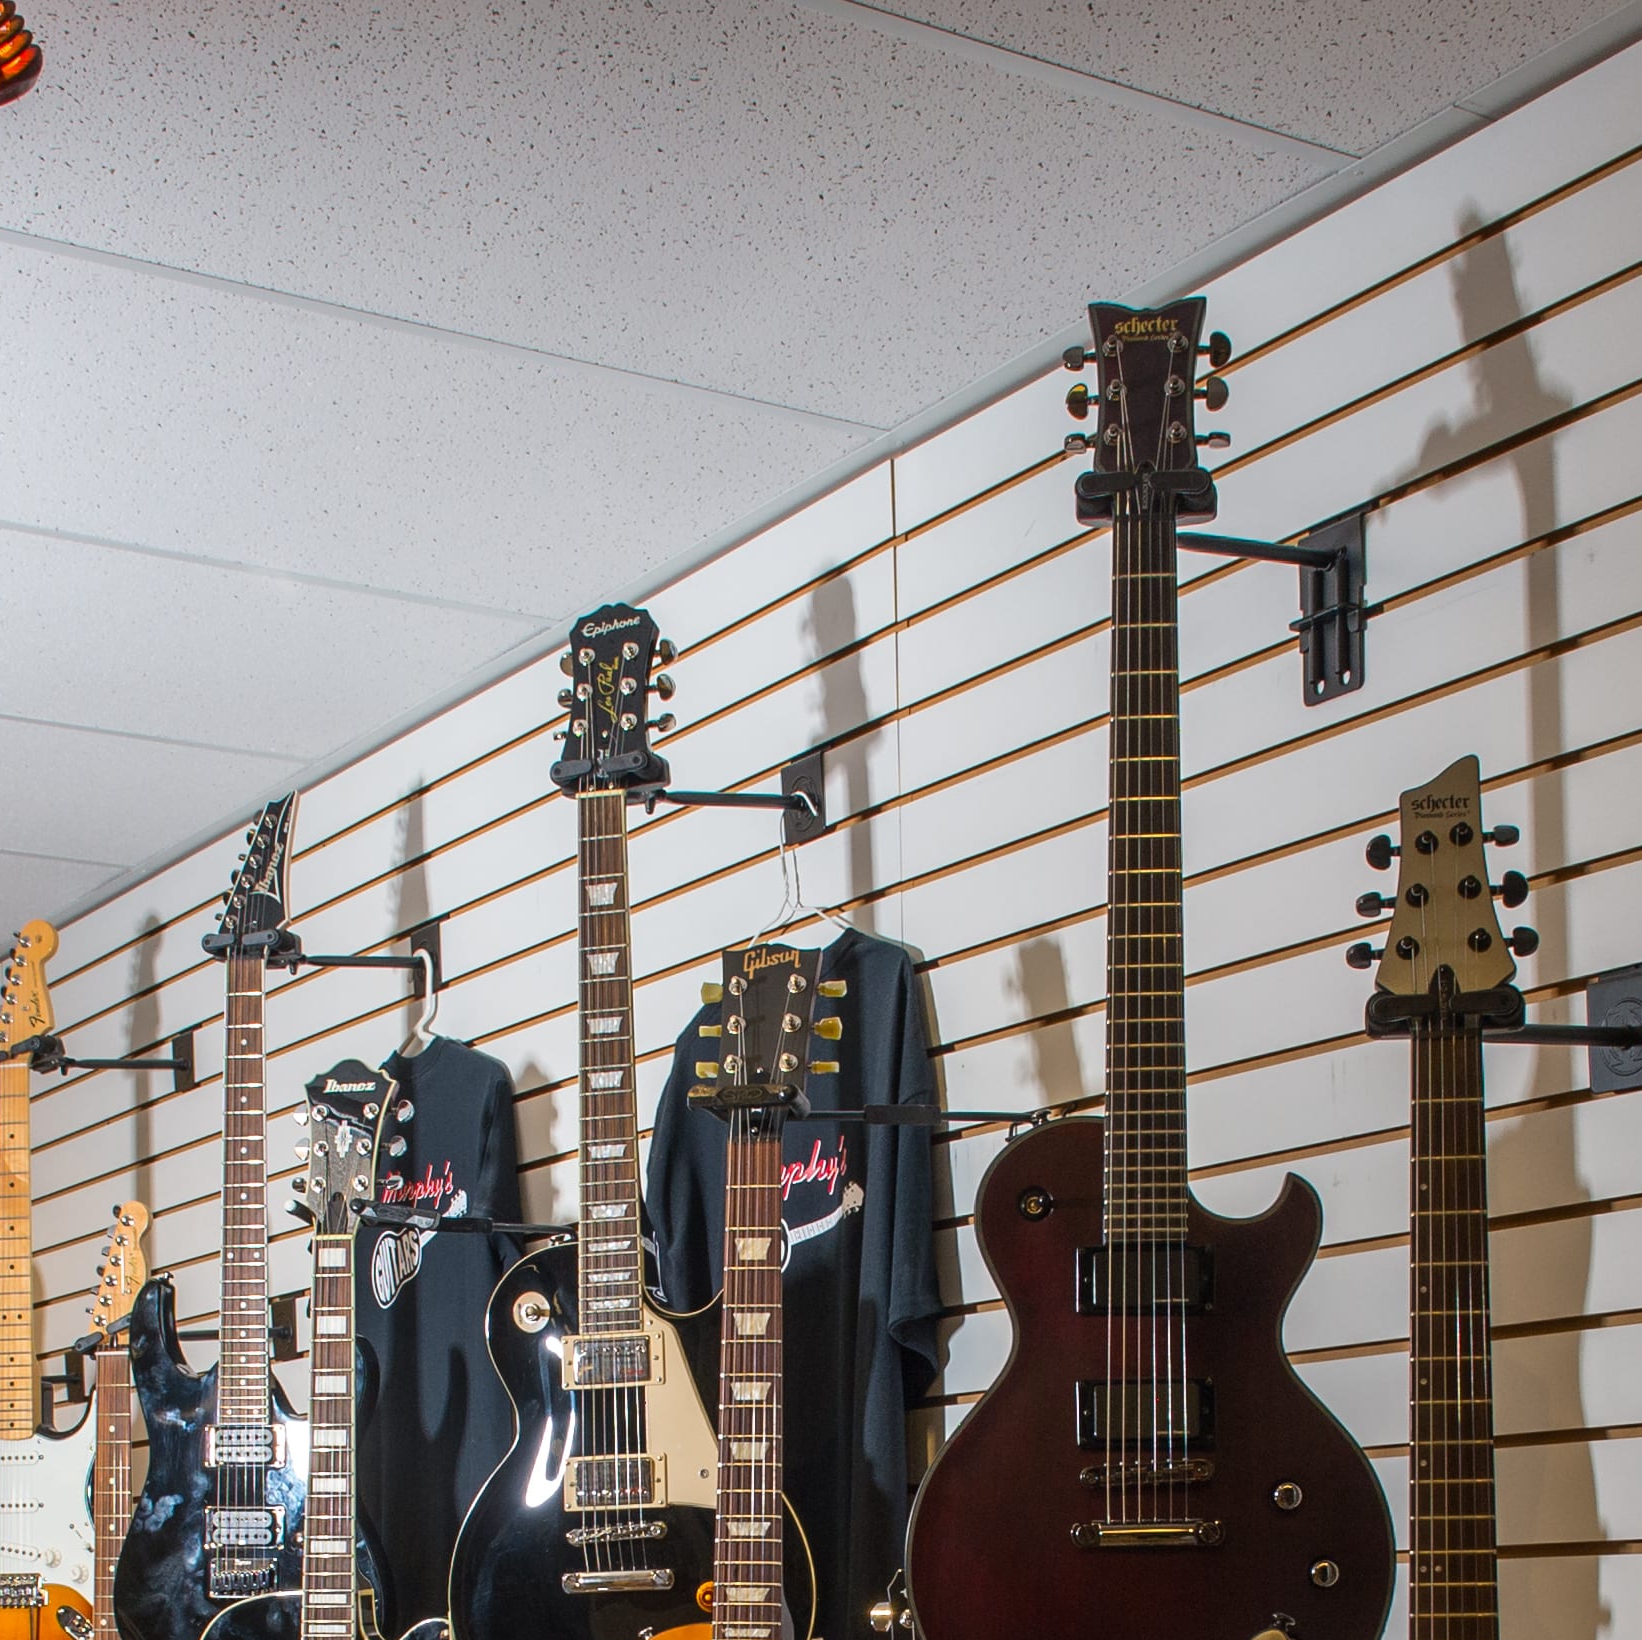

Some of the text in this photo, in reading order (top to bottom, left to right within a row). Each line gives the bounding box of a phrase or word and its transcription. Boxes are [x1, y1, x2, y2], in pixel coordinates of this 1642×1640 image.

[1114, 316, 1179, 335] schecter
[581, 615, 641, 639] Epiphone
[1411, 794, 1470, 811] schecter
[743, 948, 802, 979] Gibson
[324, 1078, 376, 1094] Ibanez
[375, 1230, 419, 1304] GUITARS
